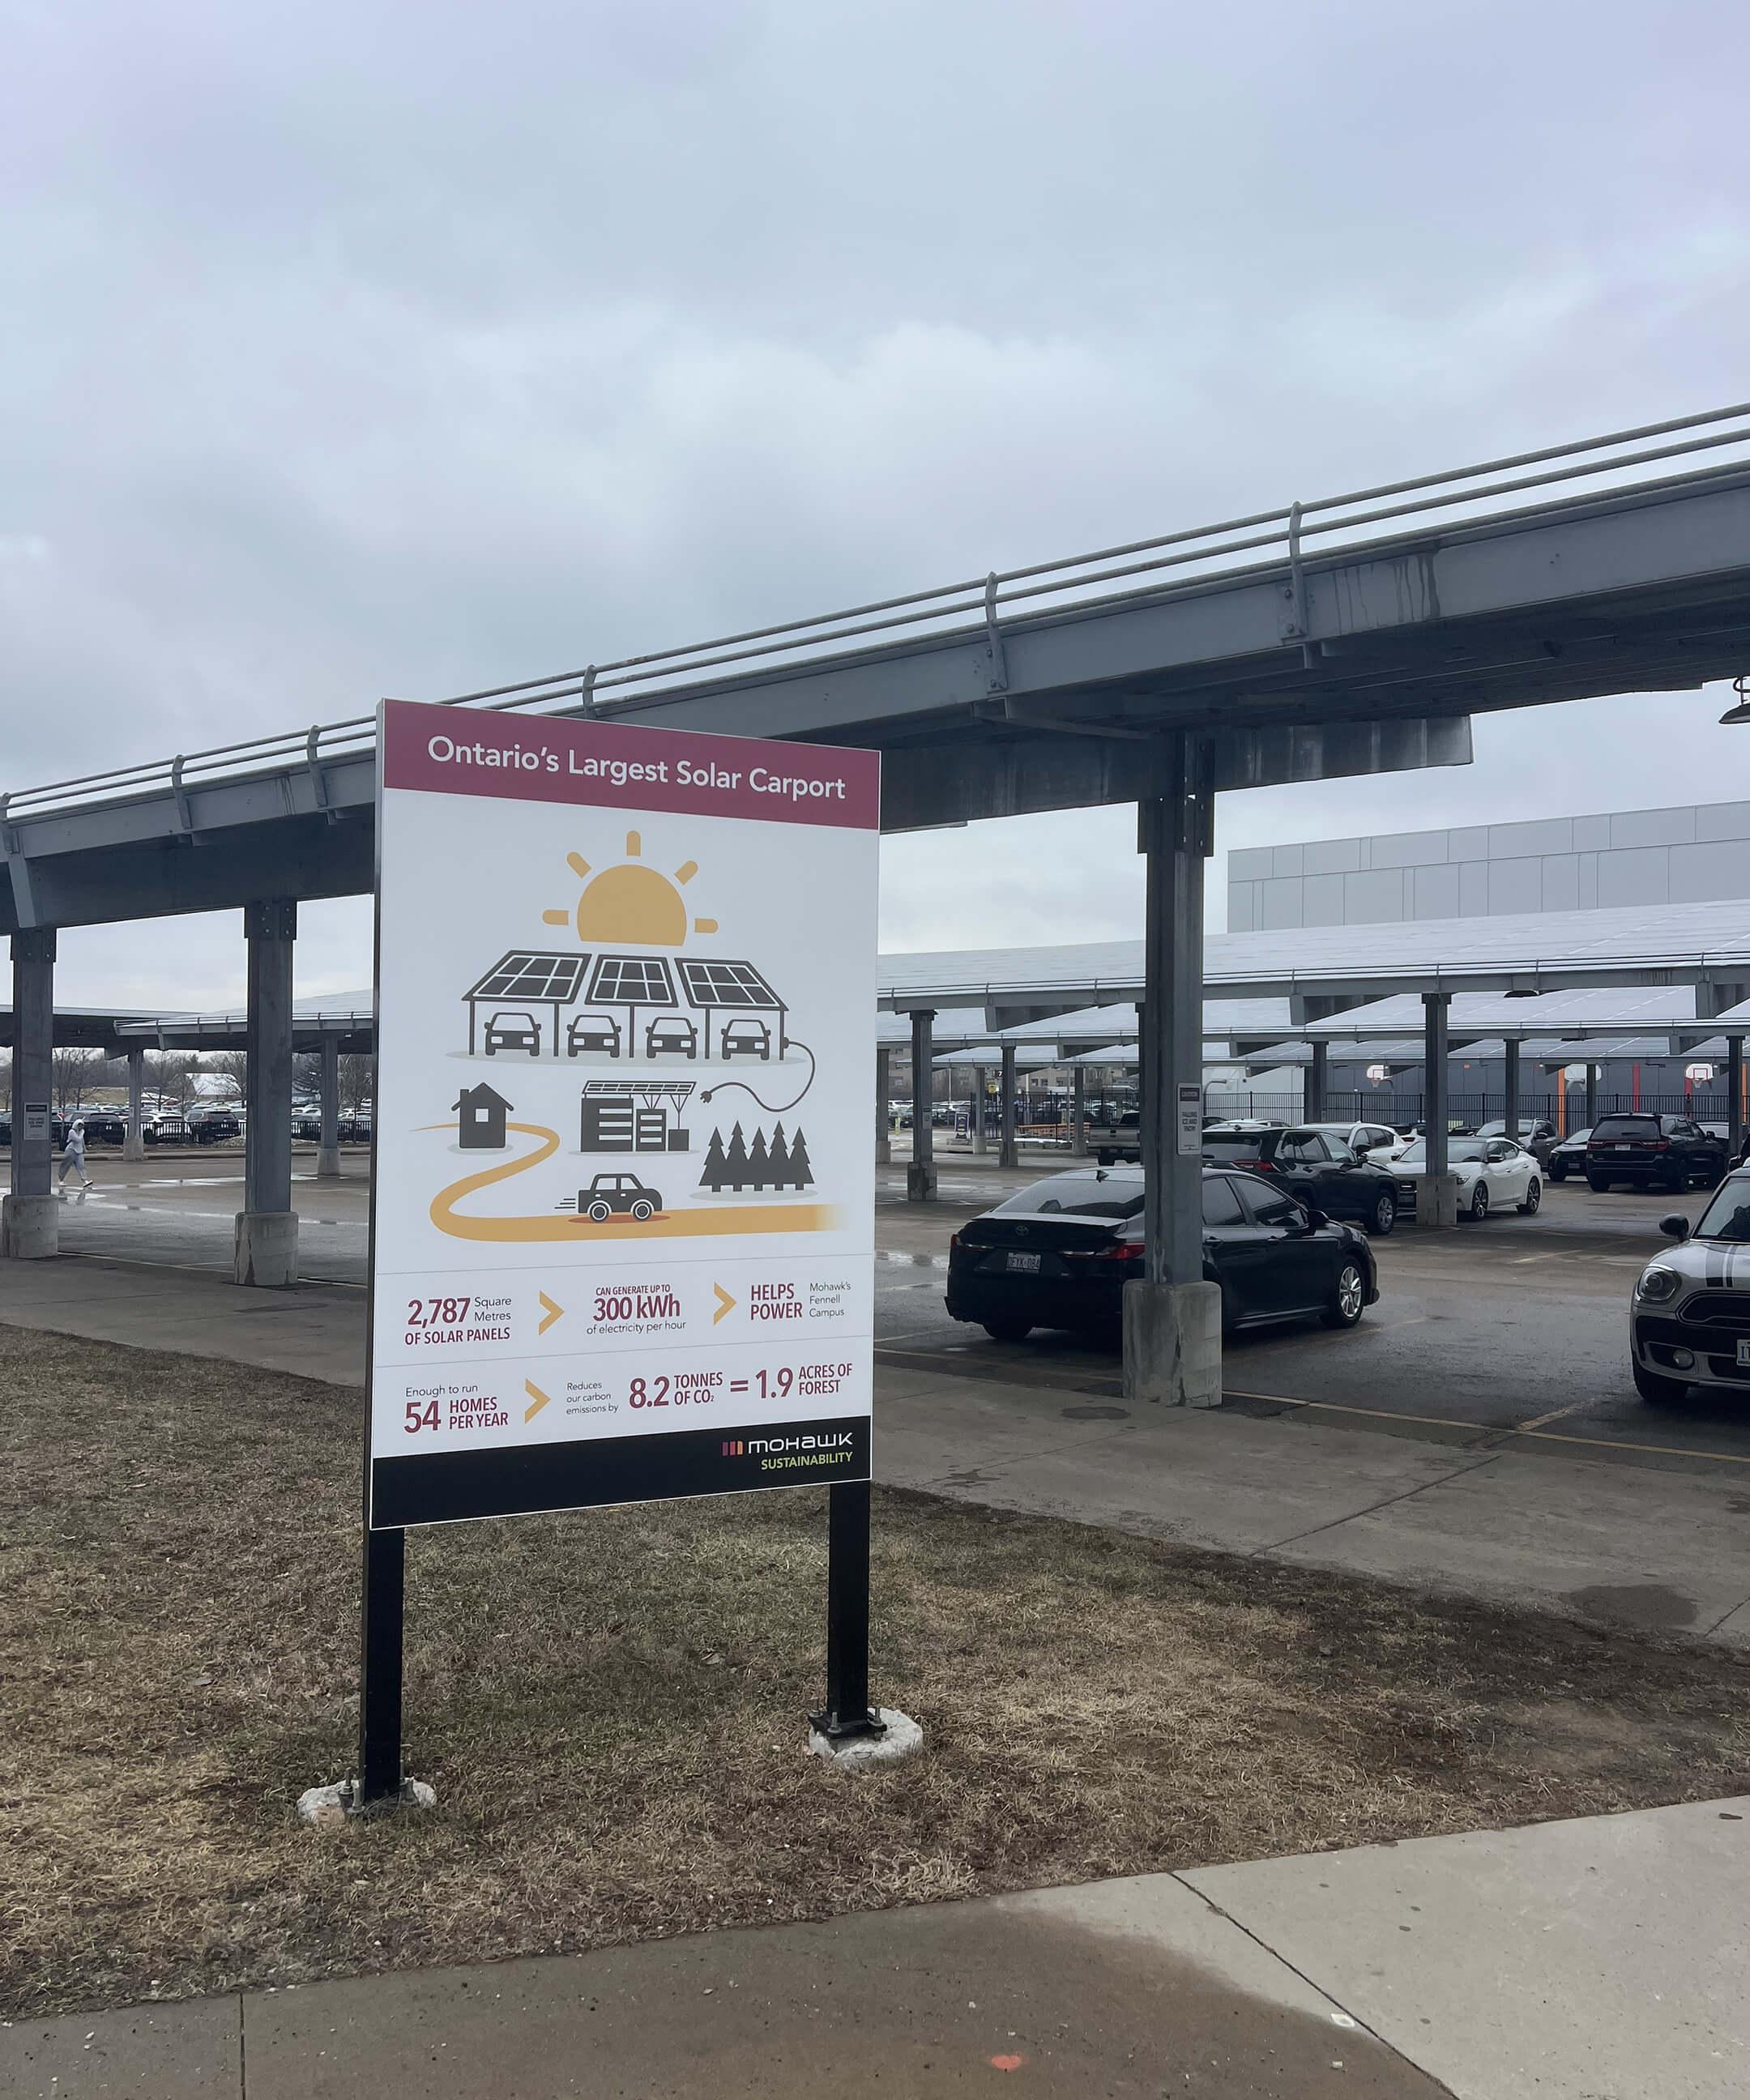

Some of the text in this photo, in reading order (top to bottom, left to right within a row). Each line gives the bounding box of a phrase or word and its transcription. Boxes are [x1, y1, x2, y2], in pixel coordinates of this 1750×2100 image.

[428, 736, 846, 802] Ontario's Largest Solar Carport
[595, 1284, 671, 1296] CAN GENERATE UP TO
[751, 1283, 795, 1301] HELPS
[809, 1281, 852, 1291] Mohawk's
[474, 1296, 512, 1309] Square
[593, 1293, 681, 1322] 300 kWh
[809, 1294, 840, 1304] Fennell
[408, 1297, 471, 1329] 2,787
[474, 1312, 511, 1322] Metres
[750, 1302, 803, 1321] POWER
[809, 1307, 844, 1320] Campus
[405, 1327, 510, 1345] OF SOLAR PANELS
[587, 1321, 686, 1334] of electricity per hour
[799, 1363, 852, 1380] ACRES OF
[566, 1382, 602, 1391] Reduces
[674, 1372, 723, 1389] TONNES
[755, 1368, 793, 1399] 1.9
[799, 1380, 840, 1395] FOREST
[406, 1385, 478, 1398] Enough to run
[583, 1393, 611, 1402] carbon
[630, 1376, 670, 1409] 8.2
[674, 1390, 690, 1406] OF
[450, 1397, 497, 1414] HOMES
[566, 1402, 619, 1415] emissions by
[403, 1400, 441, 1433] 54
[449, 1412, 509, 1429] PER YEAR
[761, 1451, 853, 1470] SUSTAINABILITY
